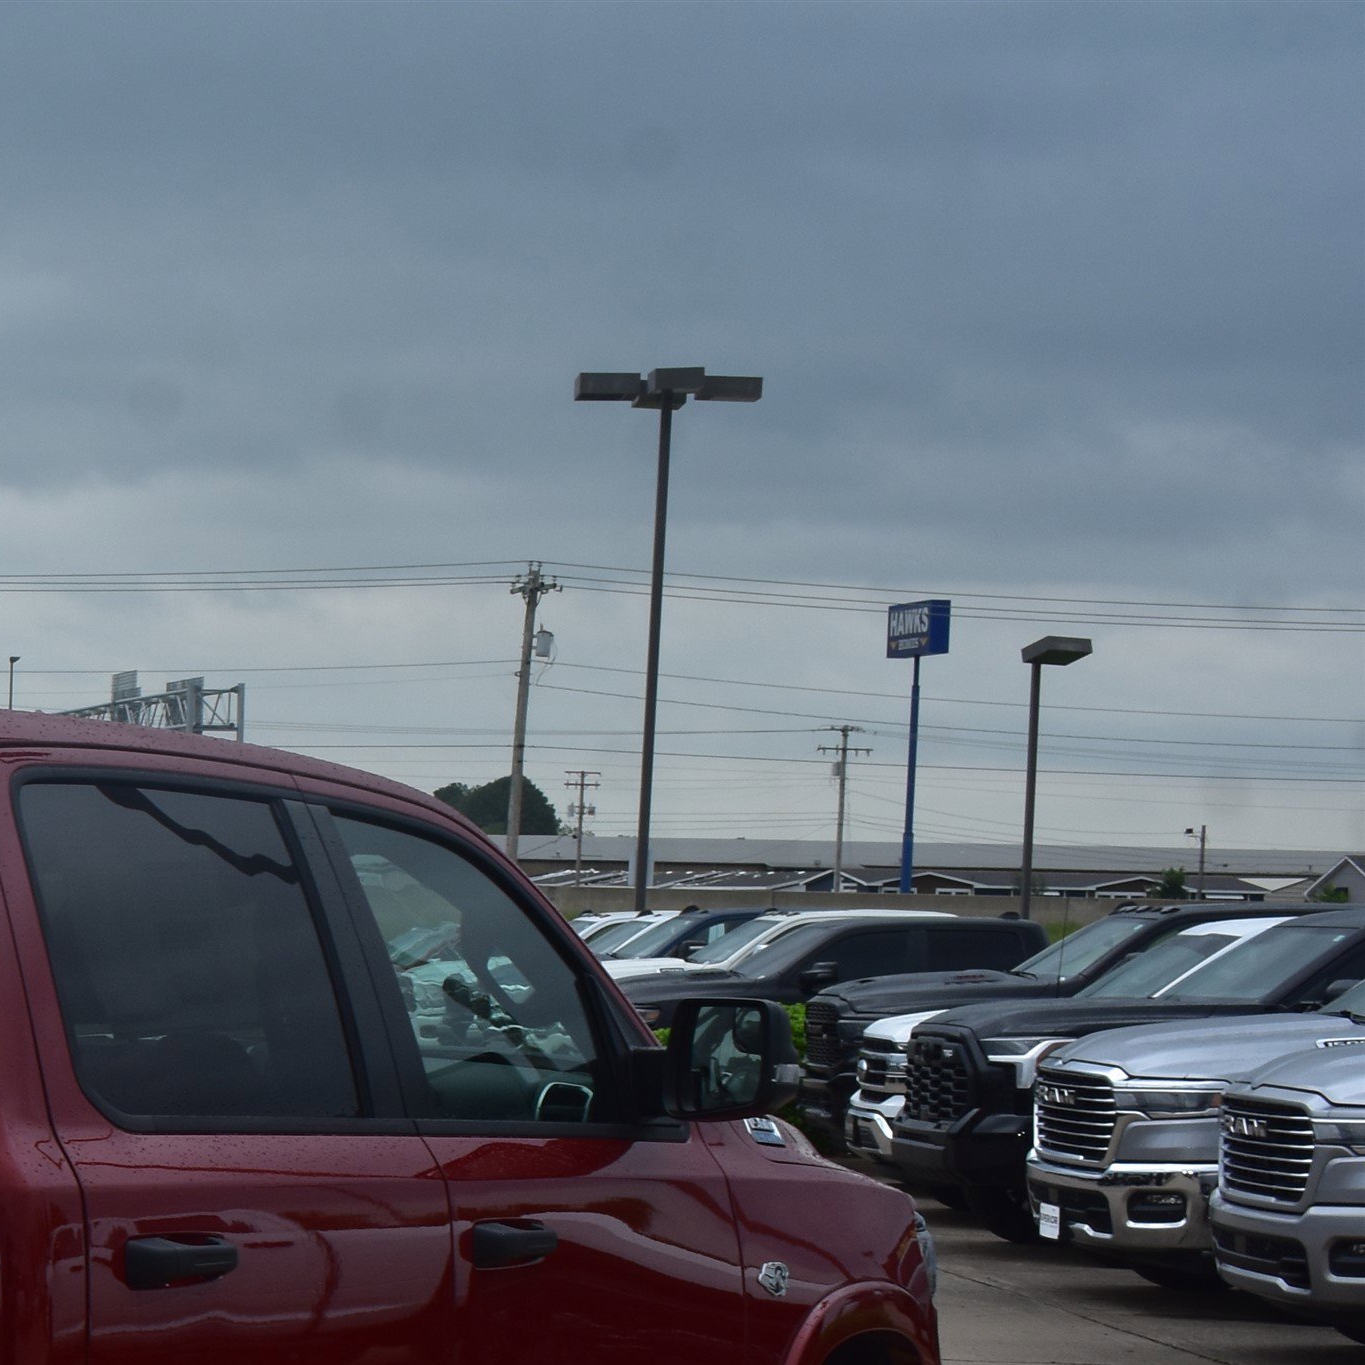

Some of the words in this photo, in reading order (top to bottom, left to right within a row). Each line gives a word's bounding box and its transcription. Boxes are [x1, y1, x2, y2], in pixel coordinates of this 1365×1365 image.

[889, 607, 929, 637] HAWKS
[1036, 1084, 1076, 1105] RAM
[1221, 1114, 1268, 1137] RAM
